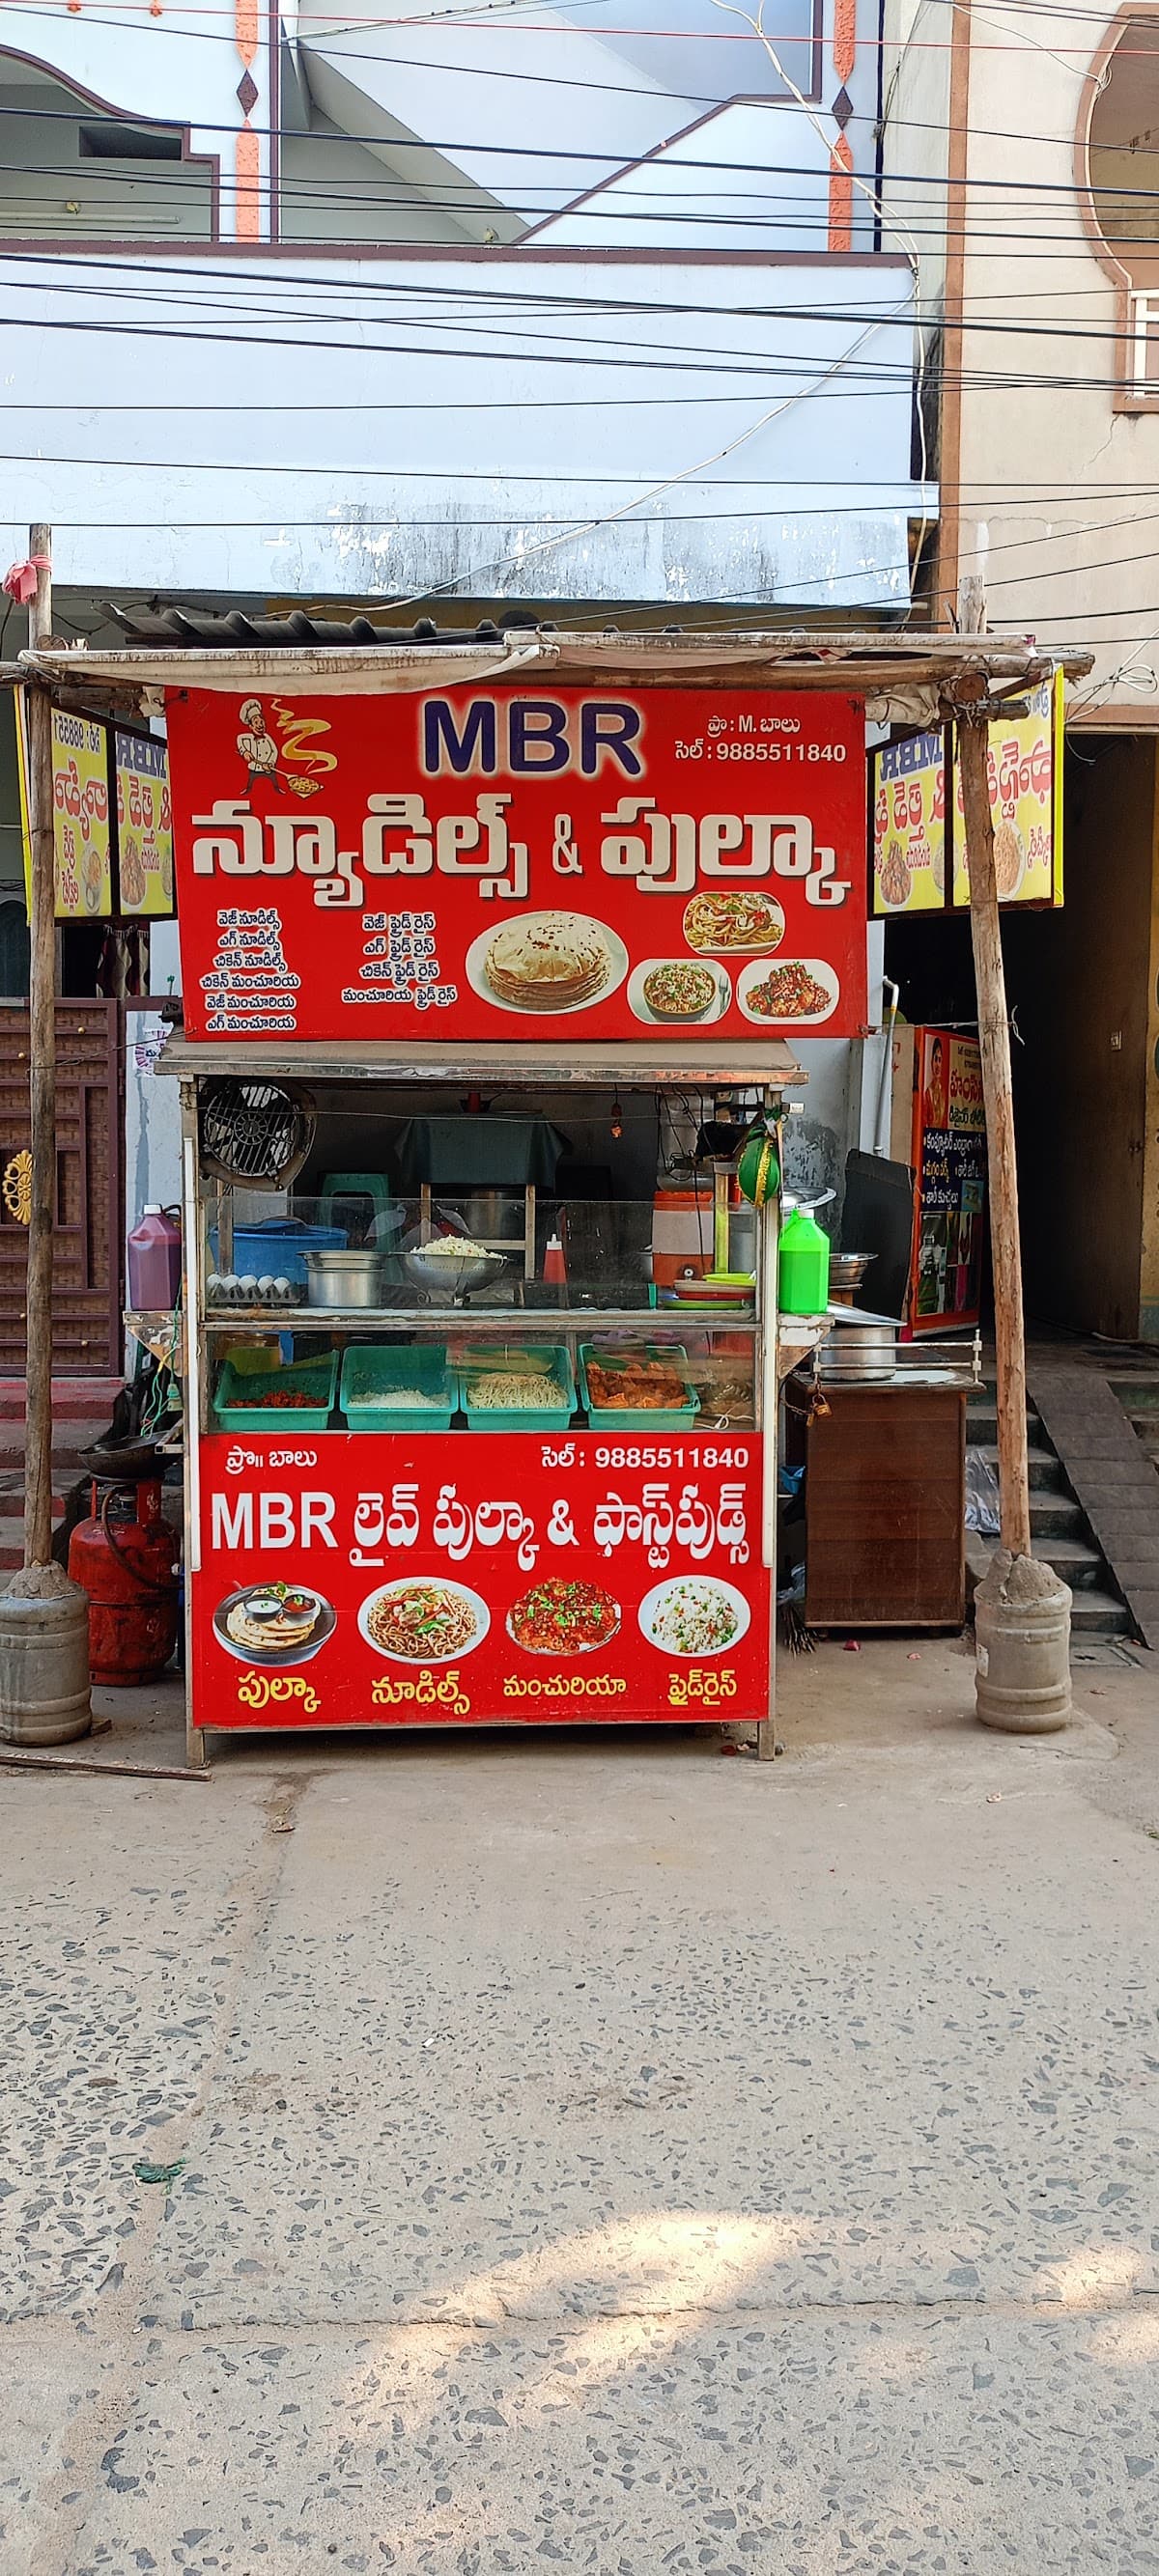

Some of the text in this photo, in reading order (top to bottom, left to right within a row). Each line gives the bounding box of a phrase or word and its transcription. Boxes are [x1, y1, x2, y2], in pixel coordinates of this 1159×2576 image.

[760, 717, 801, 734] బాలు
[422, 699, 644, 776] MBR
[716, 742, 847, 762] 9885511840
[191, 793, 529, 909] న్యూడిల్స్
[551, 813, 582, 875] &
[600, 797, 852, 906] పుల్కా
[218, 910, 280, 931] వెజ్ నూడిల్స్
[363, 913, 385, 929] వెజ్
[413, 913, 435, 934] రైస్
[219, 930, 280, 951] ఎగ్ నూడిల్స్
[364, 938, 384, 953] ఎగ్
[413, 938, 435, 958] రైస్
[214, 952, 286, 972] చికెన్ నూడిల్స్
[360, 962, 392, 977] చికెన్
[417, 962, 438, 982] రైస్
[201, 972, 229, 988] చికెన్
[207, 994, 225, 1008] వెజ్
[438, 986, 457, 1005] రైస్
[208, 1014, 225, 1029] ఎగ్
[269, 1450, 318, 1468] బాలు
[595, 1447, 749, 1469] 9885511840
[211, 1492, 338, 1550] MBR
[349, 1483, 419, 1567] లైవ్
[432, 1482, 541, 1572] పుల్కా
[546, 1498, 580, 1547] &
[237, 1670, 322, 1714] పుల్కా
[371, 1669, 470, 1716] నూడిల్స్
